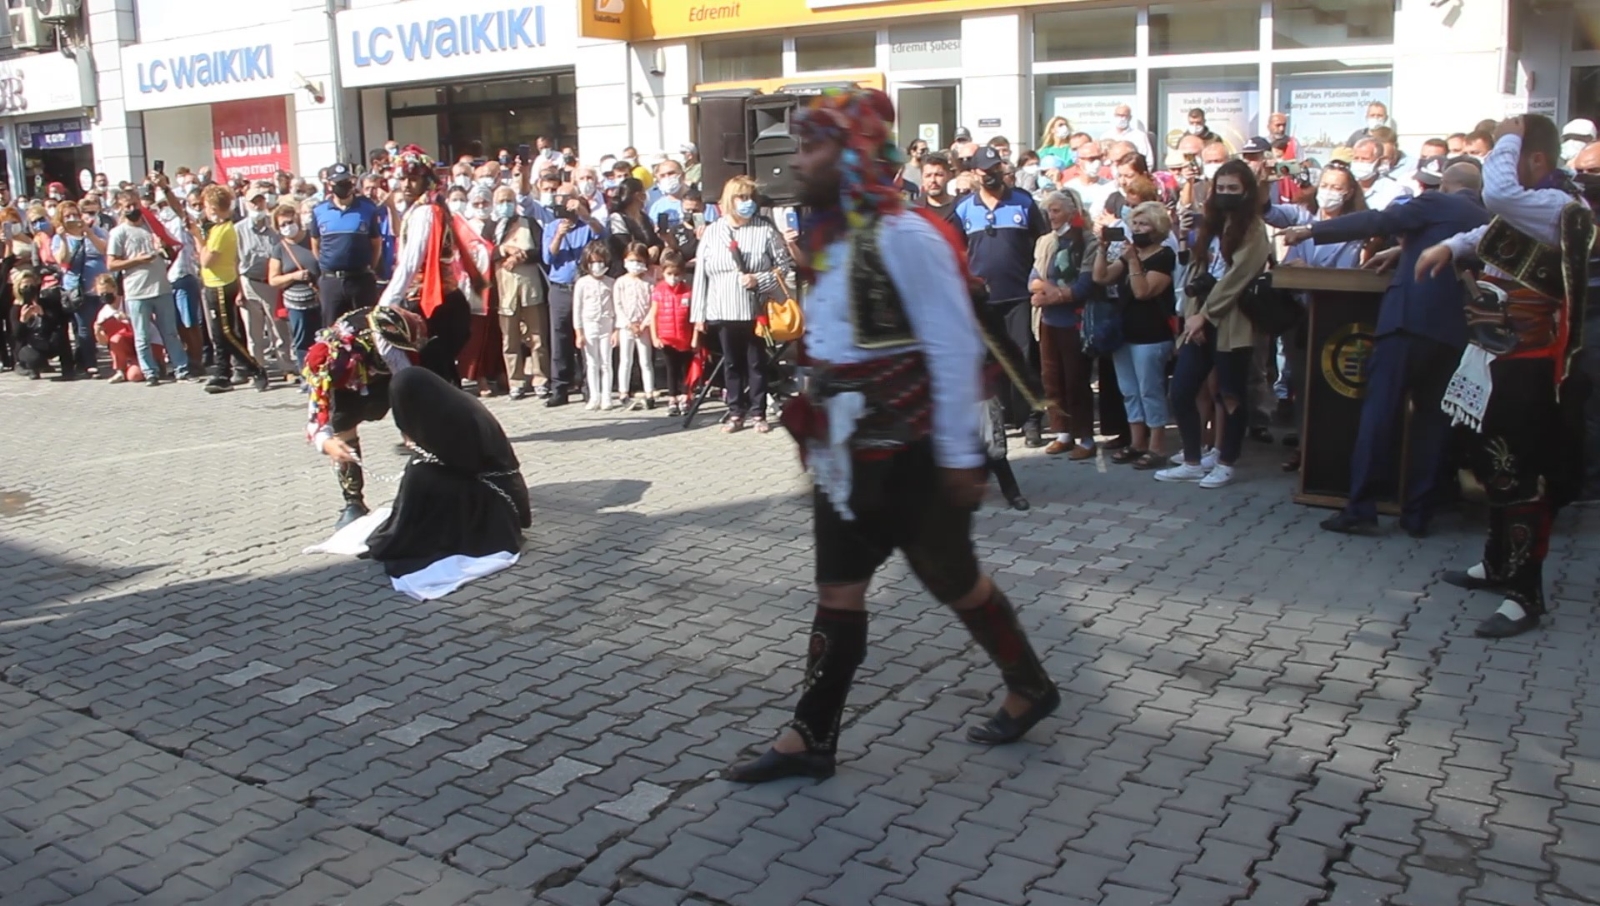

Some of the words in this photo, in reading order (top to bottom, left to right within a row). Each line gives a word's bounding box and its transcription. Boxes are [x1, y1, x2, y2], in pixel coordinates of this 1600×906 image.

[689, 2, 741, 22] Edremit
[352, 26, 393, 67] LC
[892, 43, 928, 54] Edremit
[931, 40, 961, 53] Şubesi
[137, 59, 168, 93] LC
[220, 127, 282, 159] İNDİRİM
